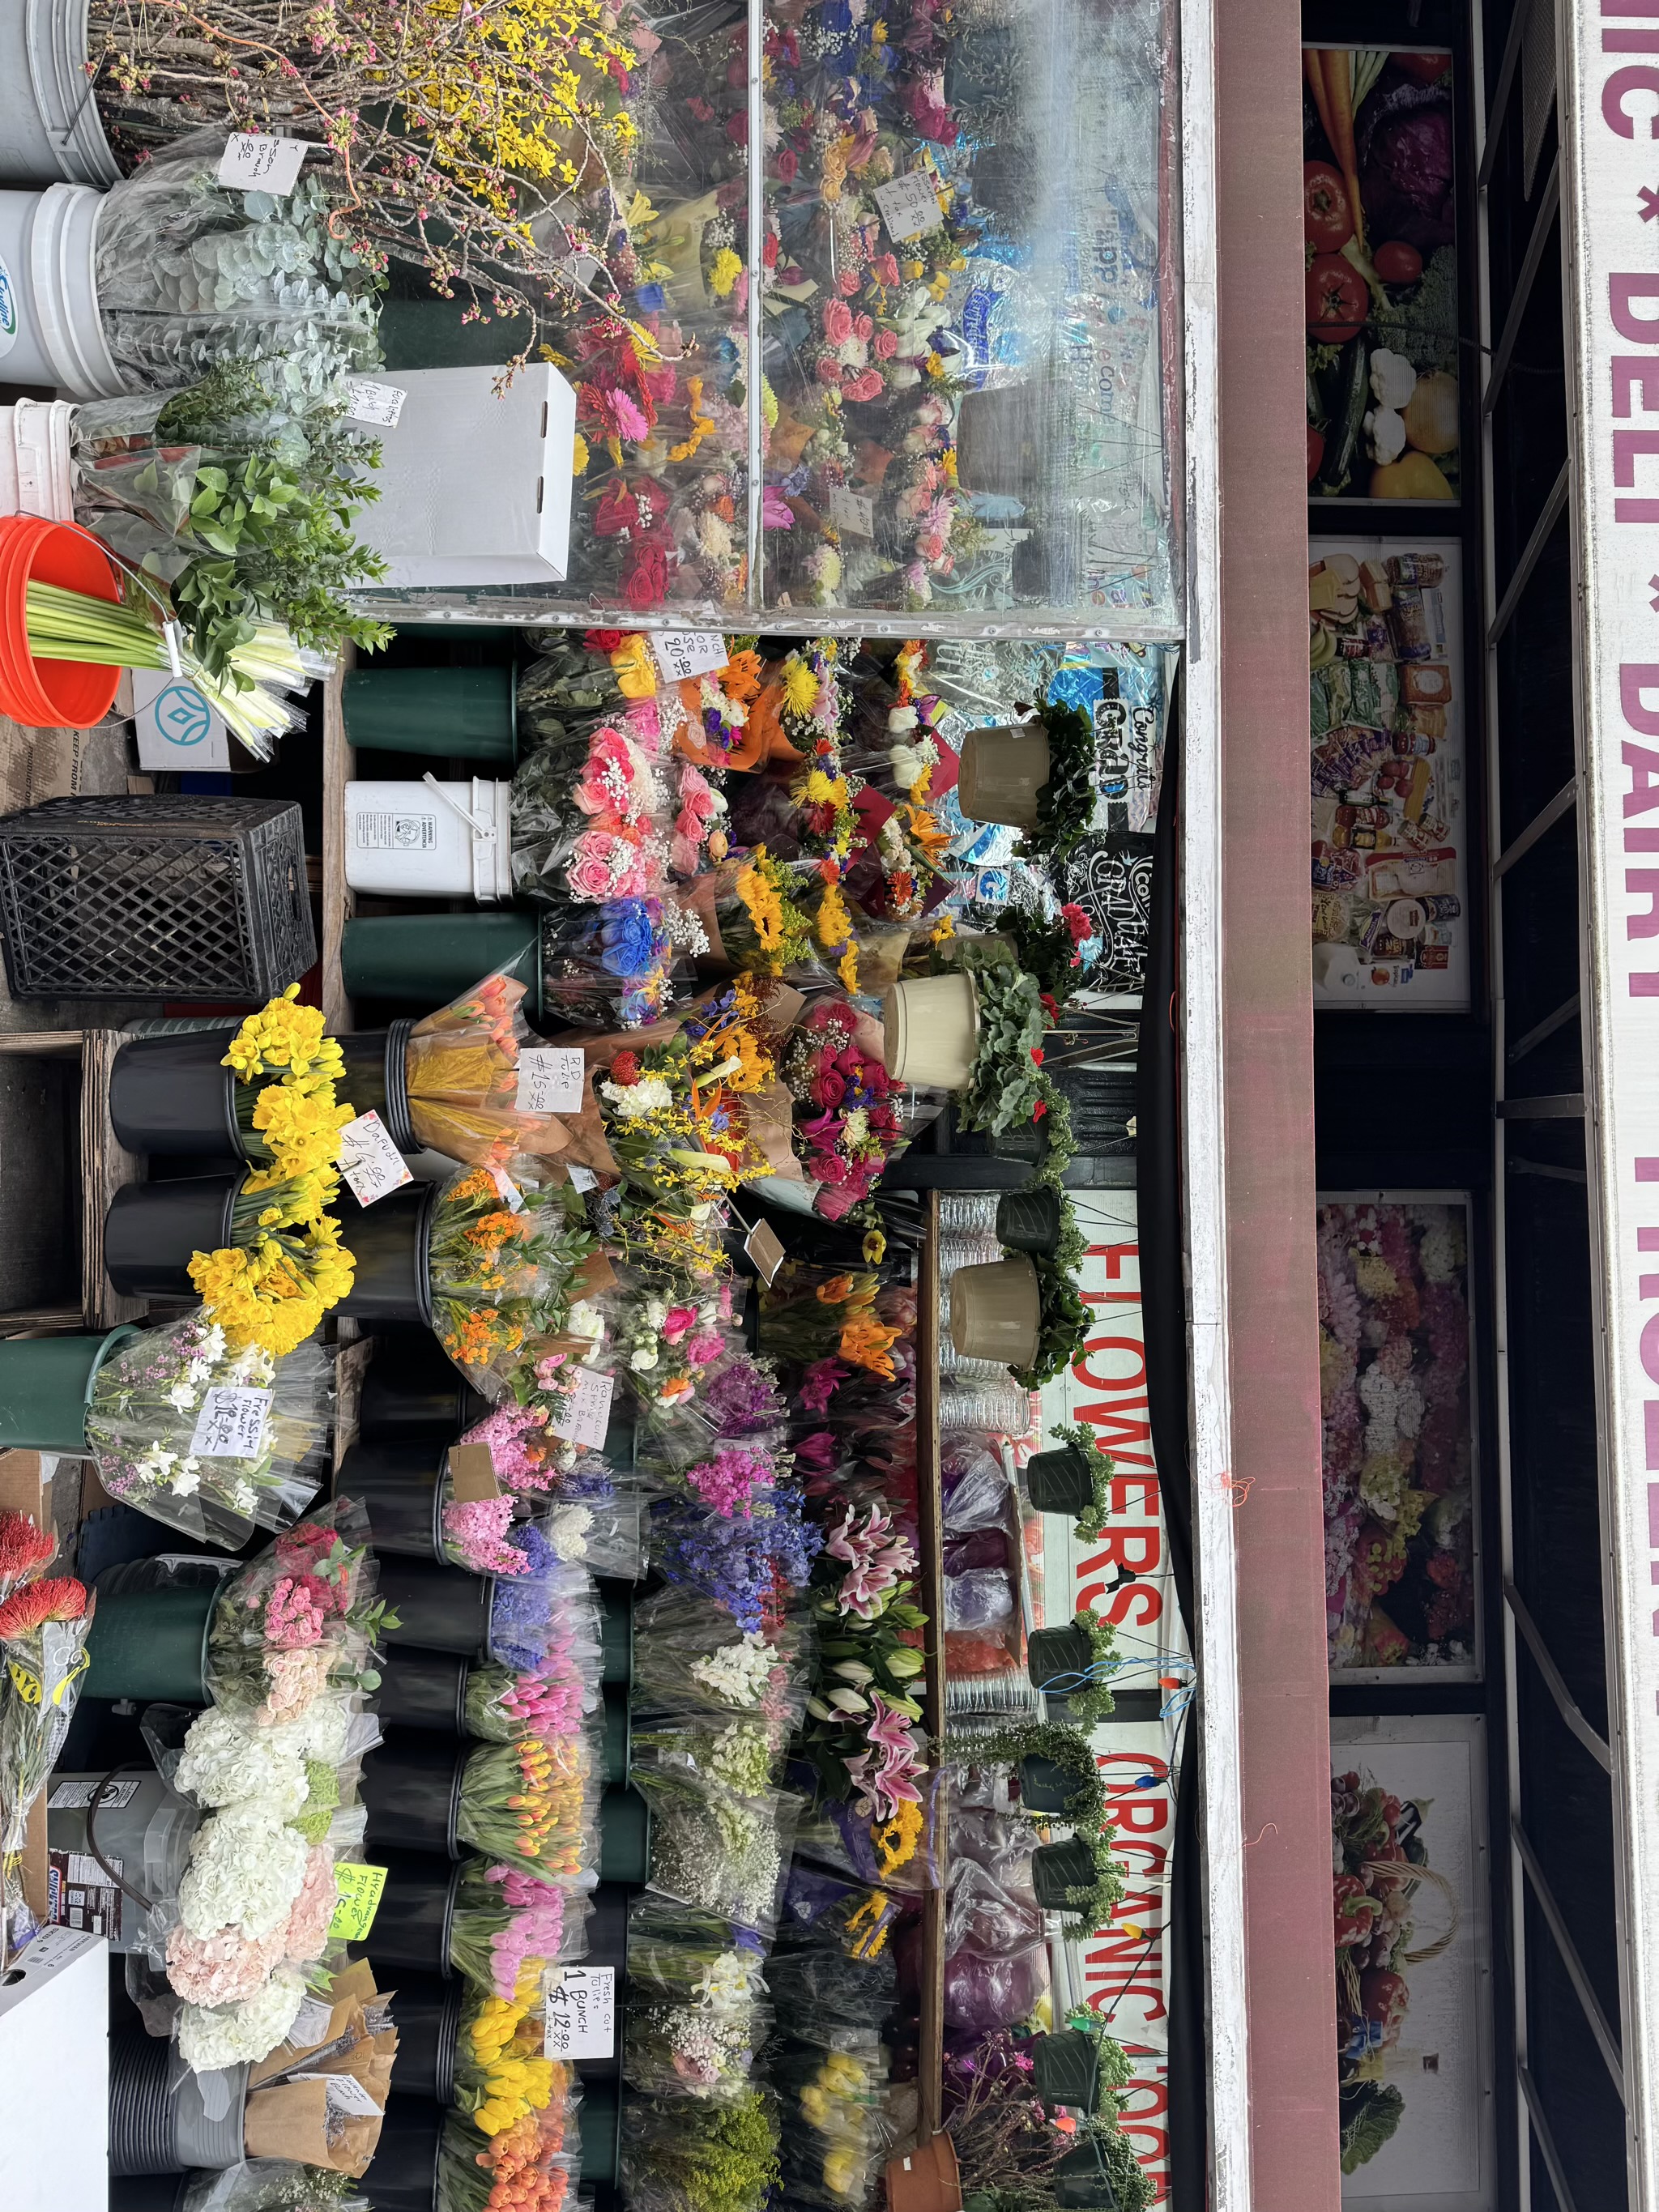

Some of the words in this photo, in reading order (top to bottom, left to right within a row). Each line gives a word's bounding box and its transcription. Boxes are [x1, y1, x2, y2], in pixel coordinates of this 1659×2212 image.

[1609, 272, 1659, 523] DELI
[25, 745, 34, 788] PRODUCT
[1095, 701, 1130, 800] GRAD
[1128, 706, 1157, 792] Congrats
[70, 758, 79, 791] FROM
[24, 791, 32, 805] OF
[1085, 1752, 1168, 2022] ORGANIC
[565, 1970, 587, 1981] 1
[601, 1973, 613, 2004] Fresh
[569, 1989, 589, 2034] BUNCH
